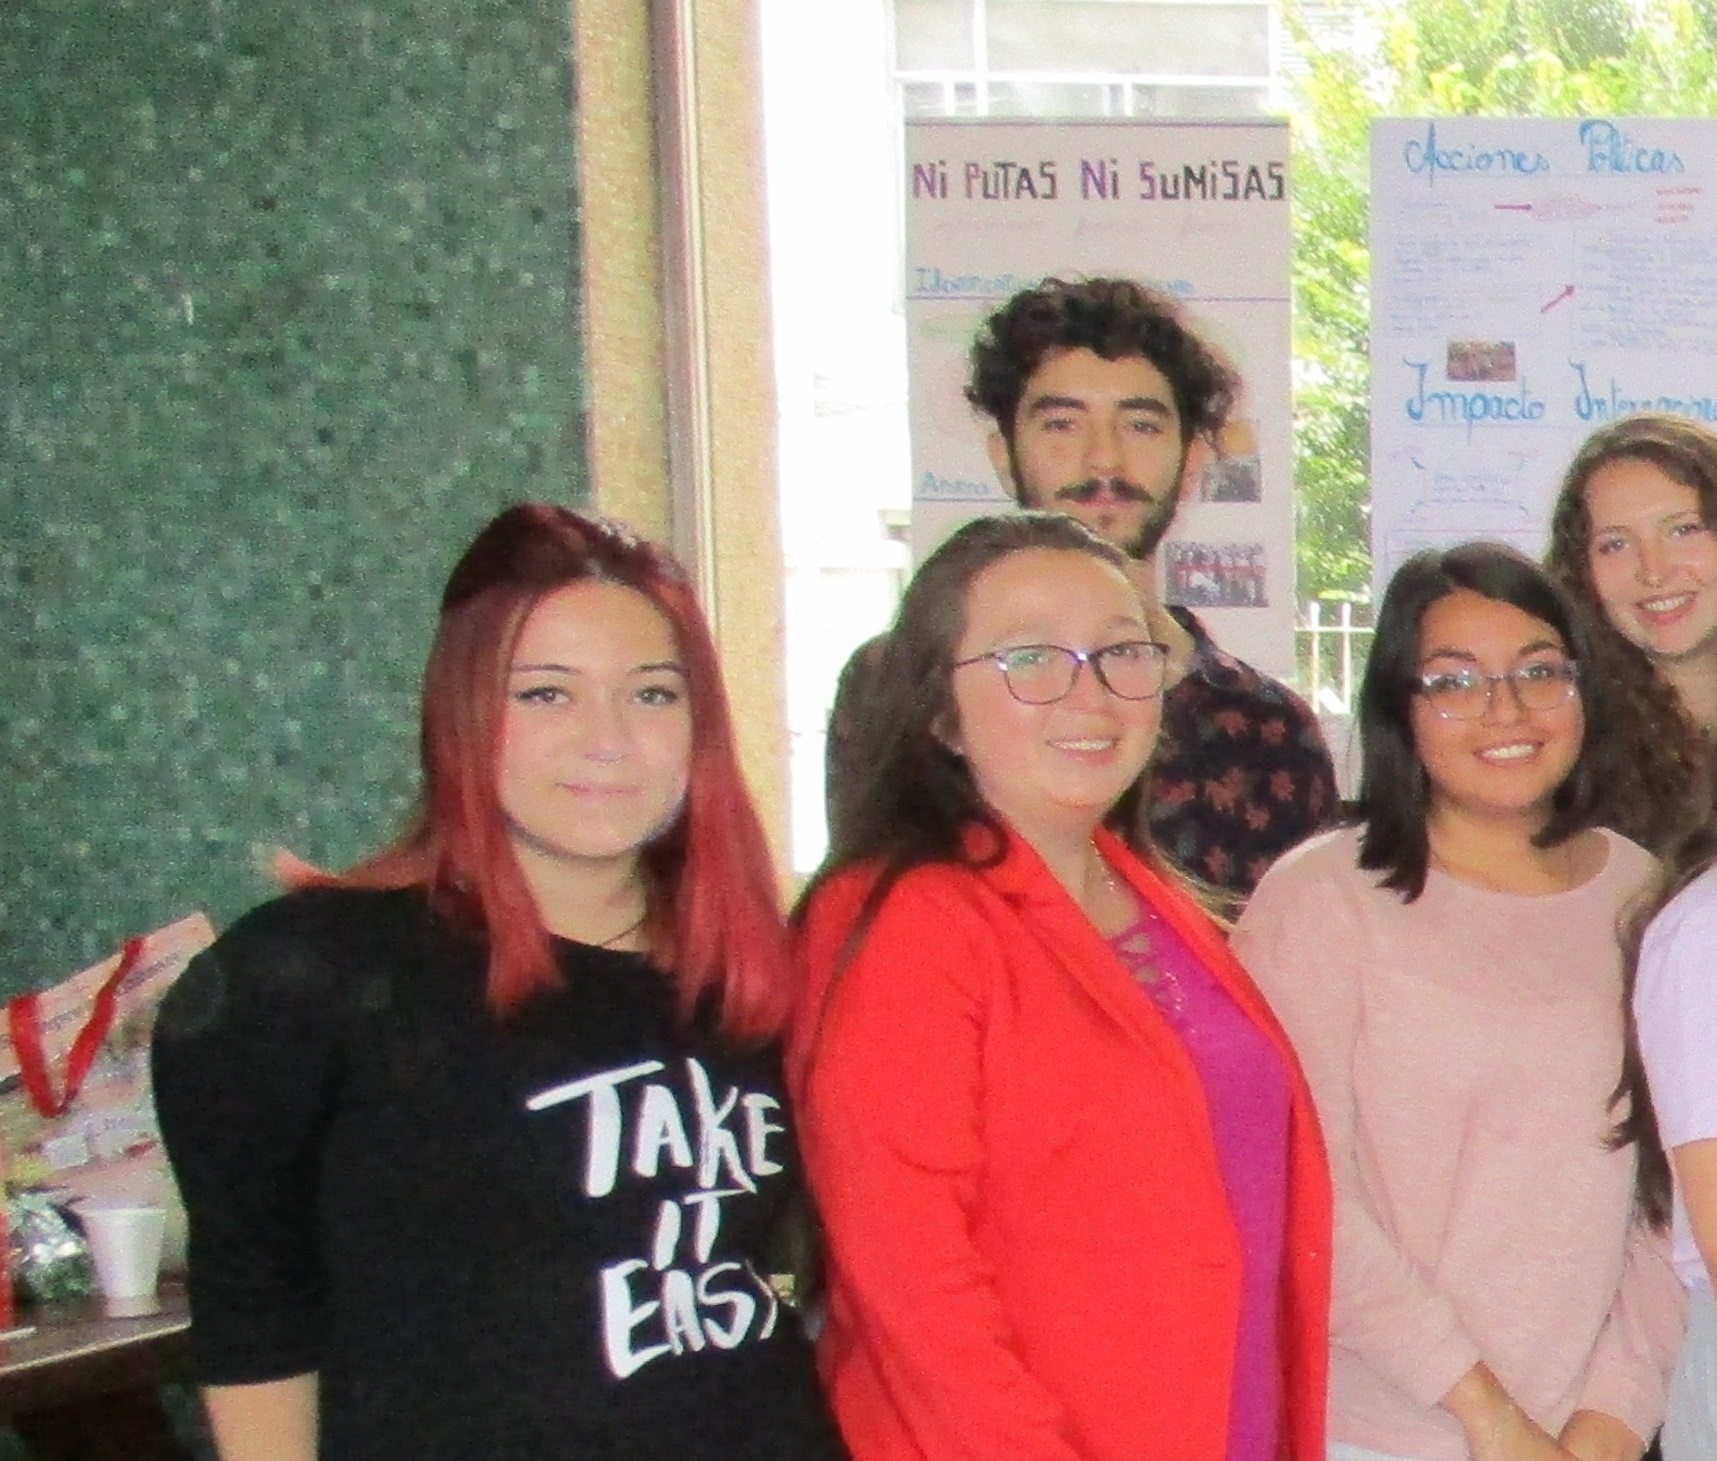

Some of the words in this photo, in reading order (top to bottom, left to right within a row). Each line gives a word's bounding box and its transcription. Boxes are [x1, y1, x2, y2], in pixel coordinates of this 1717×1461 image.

[1402, 119, 1551, 188] Acciones
[1403, 357, 1546, 440] Impacto
[526, 1057, 784, 1198] TAKE
[653, 1188, 757, 1271] IT
